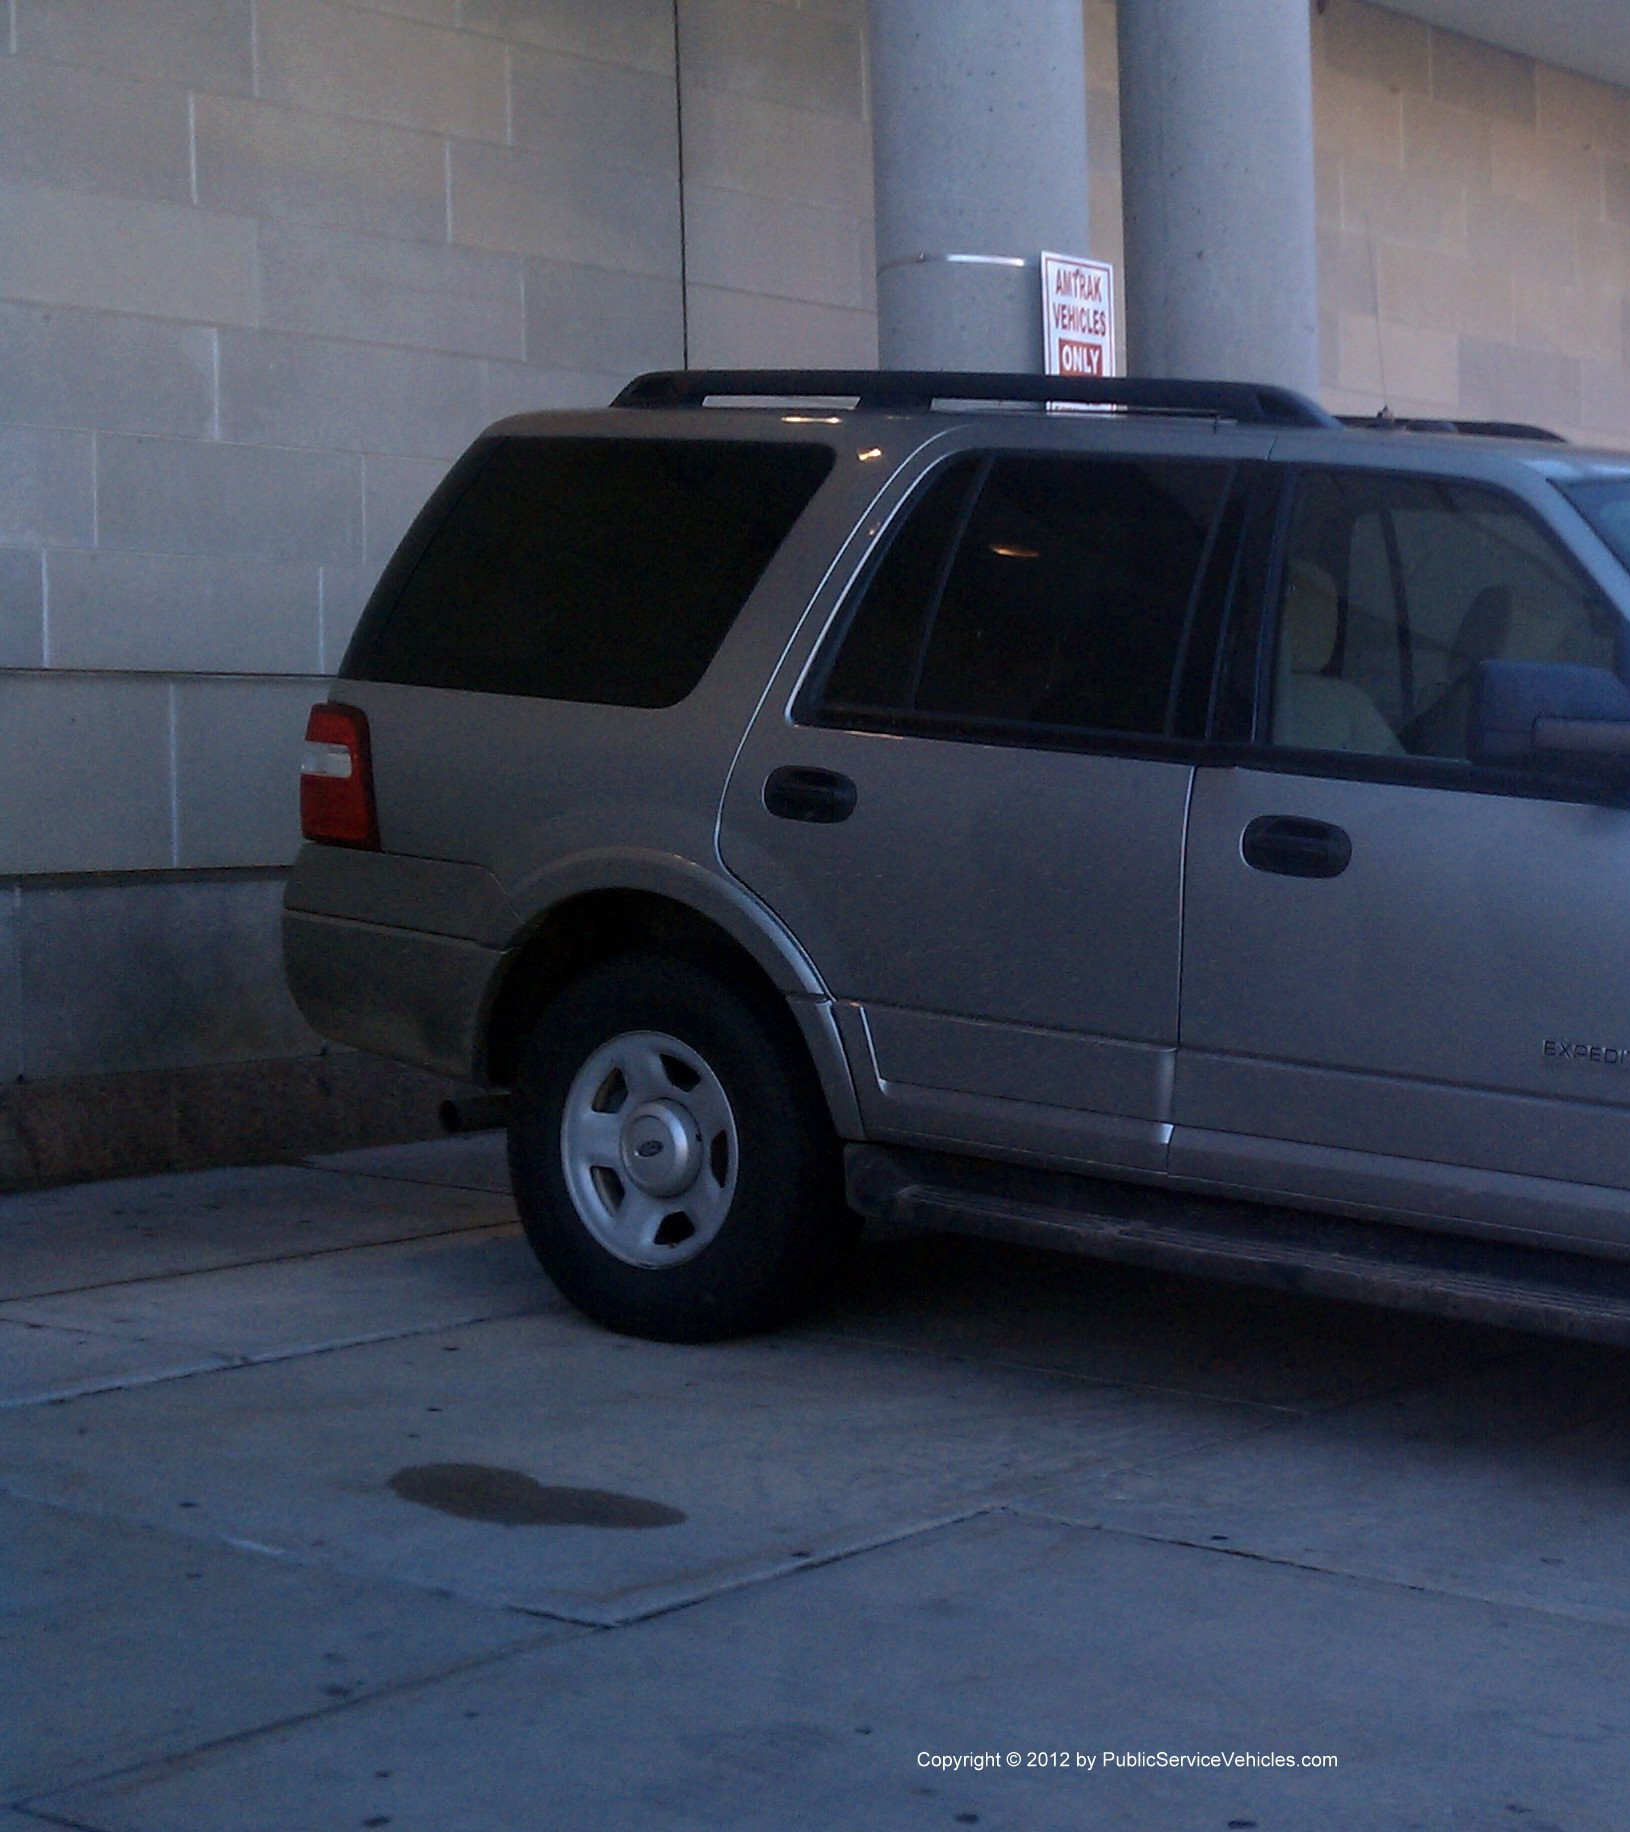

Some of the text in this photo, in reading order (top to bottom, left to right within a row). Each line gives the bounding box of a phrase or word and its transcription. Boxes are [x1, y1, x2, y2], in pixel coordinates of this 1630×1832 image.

[1056, 268, 1102, 303] AMTRAK
[1053, 303, 1107, 337] VEHICLES
[1062, 345, 1099, 374] ONLY
